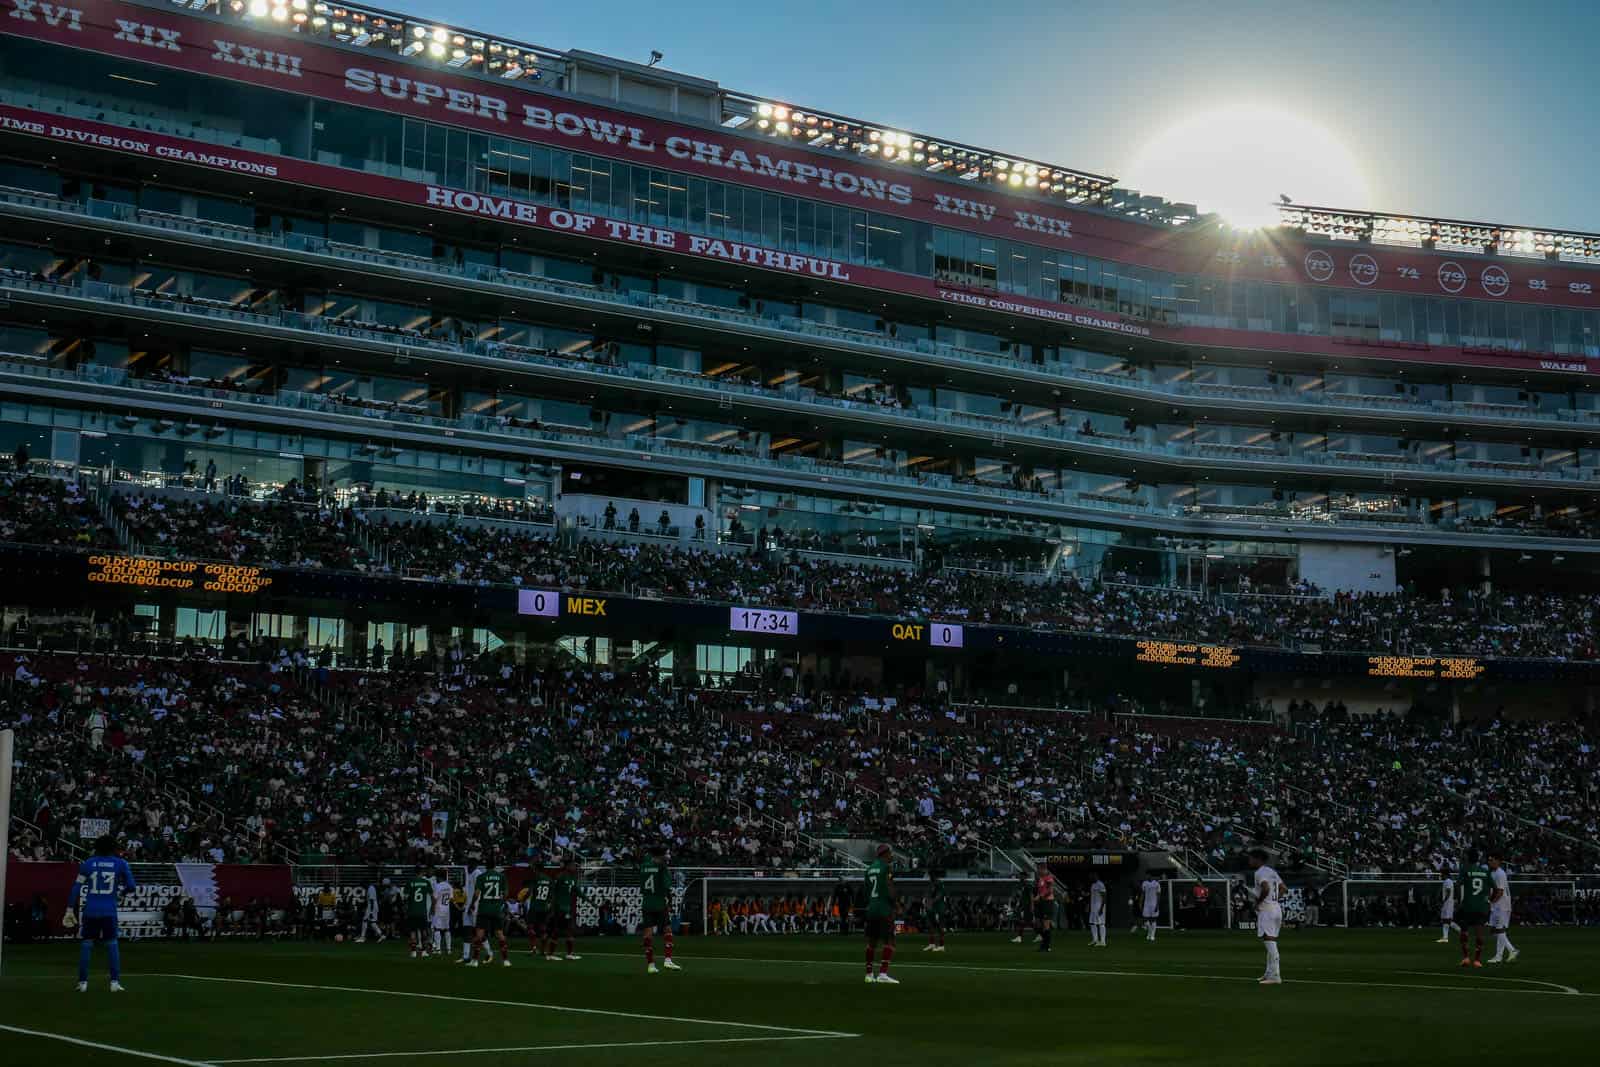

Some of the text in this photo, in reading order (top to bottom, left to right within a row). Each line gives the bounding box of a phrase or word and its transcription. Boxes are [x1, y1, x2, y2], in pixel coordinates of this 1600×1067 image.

[10, 0, 302, 76] XVI XIX XXIII
[344, 67, 913, 206] SUPER BOWL CHAMPIONS
[51, 126, 150, 152] DIVISION
[156, 145, 278, 175] CHAMPIONS
[933, 193, 1074, 239] XXIV XXIX
[427, 186, 850, 280] HOME OF THE FAITHFUL
[939, 290, 1150, 336] 7-TIME CONFERENCE CHAMPIONS
[535, 594, 545, 612] 0
[567, 597, 608, 617] MEX
[742, 611, 790, 631] 17:34
[891, 623, 925, 641] QAT
[943, 627, 952, 643] 0
[88, 871, 116, 895] 13
[483, 882, 502, 900] 21
[644, 873, 656, 895] 4
[1471, 877, 1484, 896] 9
[414, 887, 424, 903] 6
[536, 886, 550, 901] 18
